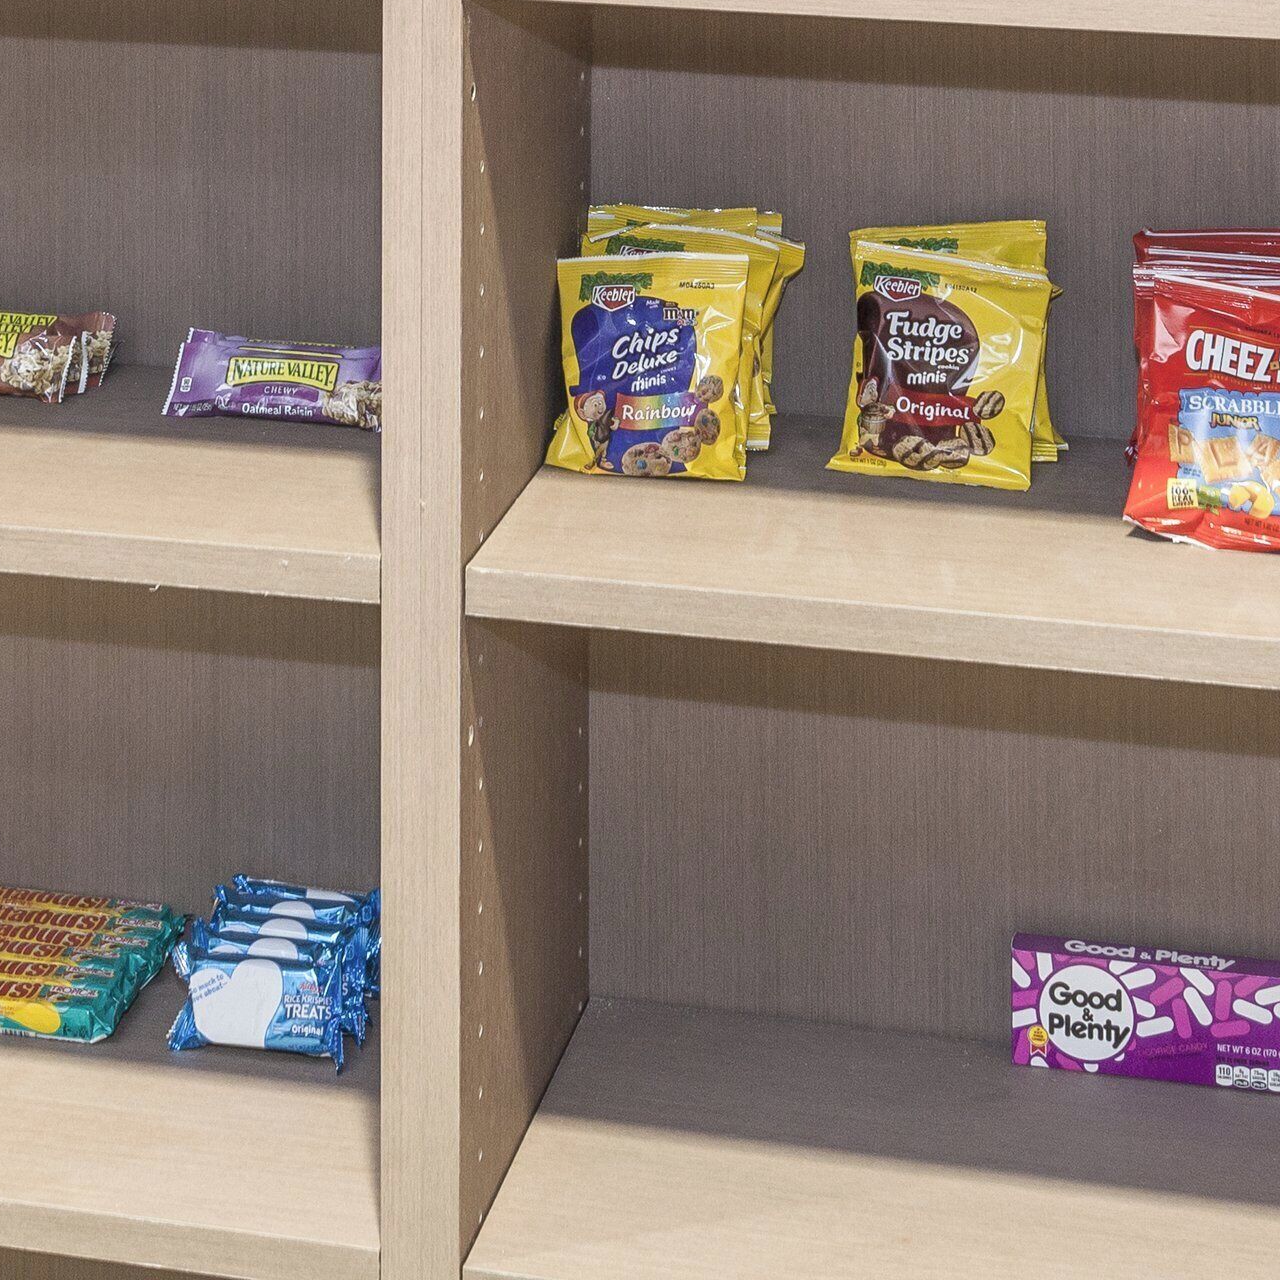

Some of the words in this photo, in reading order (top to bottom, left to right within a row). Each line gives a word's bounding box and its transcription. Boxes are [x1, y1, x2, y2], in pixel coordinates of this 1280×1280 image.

[593, 286, 634, 304] Keebler
[875, 277, 920, 296] Keebler
[886, 311, 963, 344] Fudge
[612, 328, 680, 359] Chips
[886, 337, 969, 366] Stripes
[233, 358, 286, 380] NATURE
[287, 361, 335, 387] VALLEY
[612, 350, 677, 380] Deluxe
[264, 385, 298, 395] CHEWY
[622, 404, 696, 421] Rainbow
[896, 396, 970, 421] Original
[1211, 412, 1261, 430] JUNIOR
[49, 986, 99, 998] TROPICAL
[284, 995, 300, 1005] RICE
[301, 995, 333, 1006] KRISPIES
[1048, 981, 1122, 1012] Good
[285, 1004, 332, 1020] TREATS
[1048, 1013, 1130, 1048] Plenty
[1218, 1066, 1231, 1075] 110
